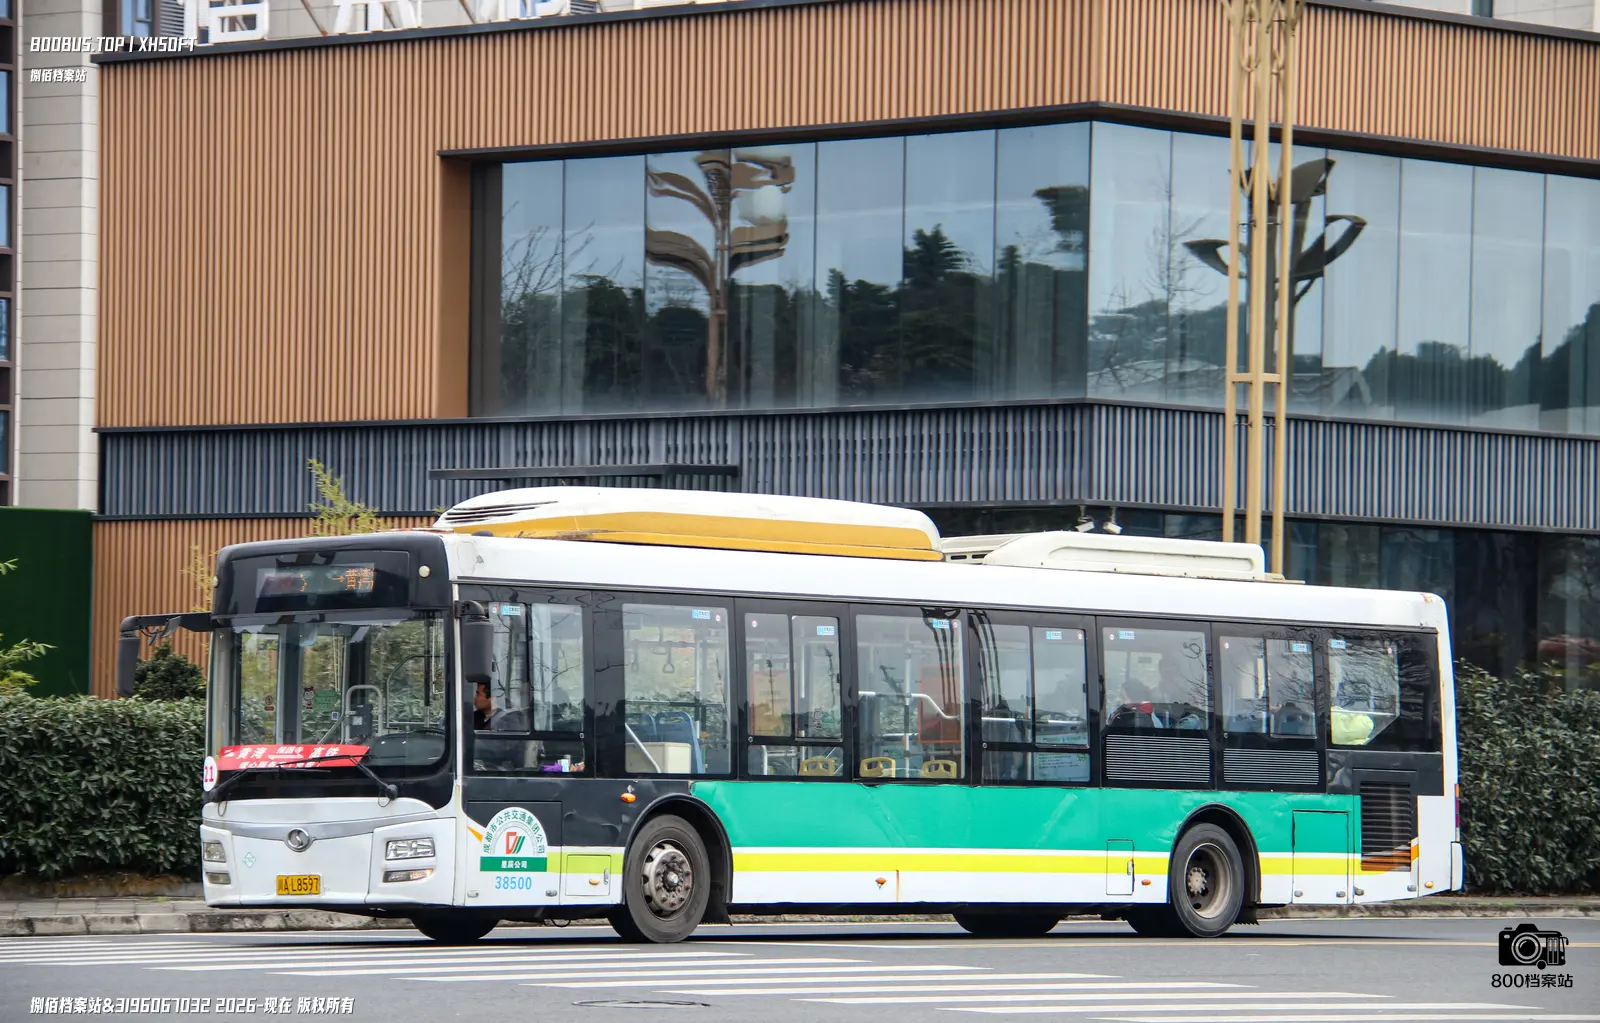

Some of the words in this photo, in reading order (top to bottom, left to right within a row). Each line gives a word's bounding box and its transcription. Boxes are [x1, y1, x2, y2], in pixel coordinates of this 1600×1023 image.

[483, 809, 545, 854] 成都市公共交通集团公司
[495, 876, 532, 890] 38500
